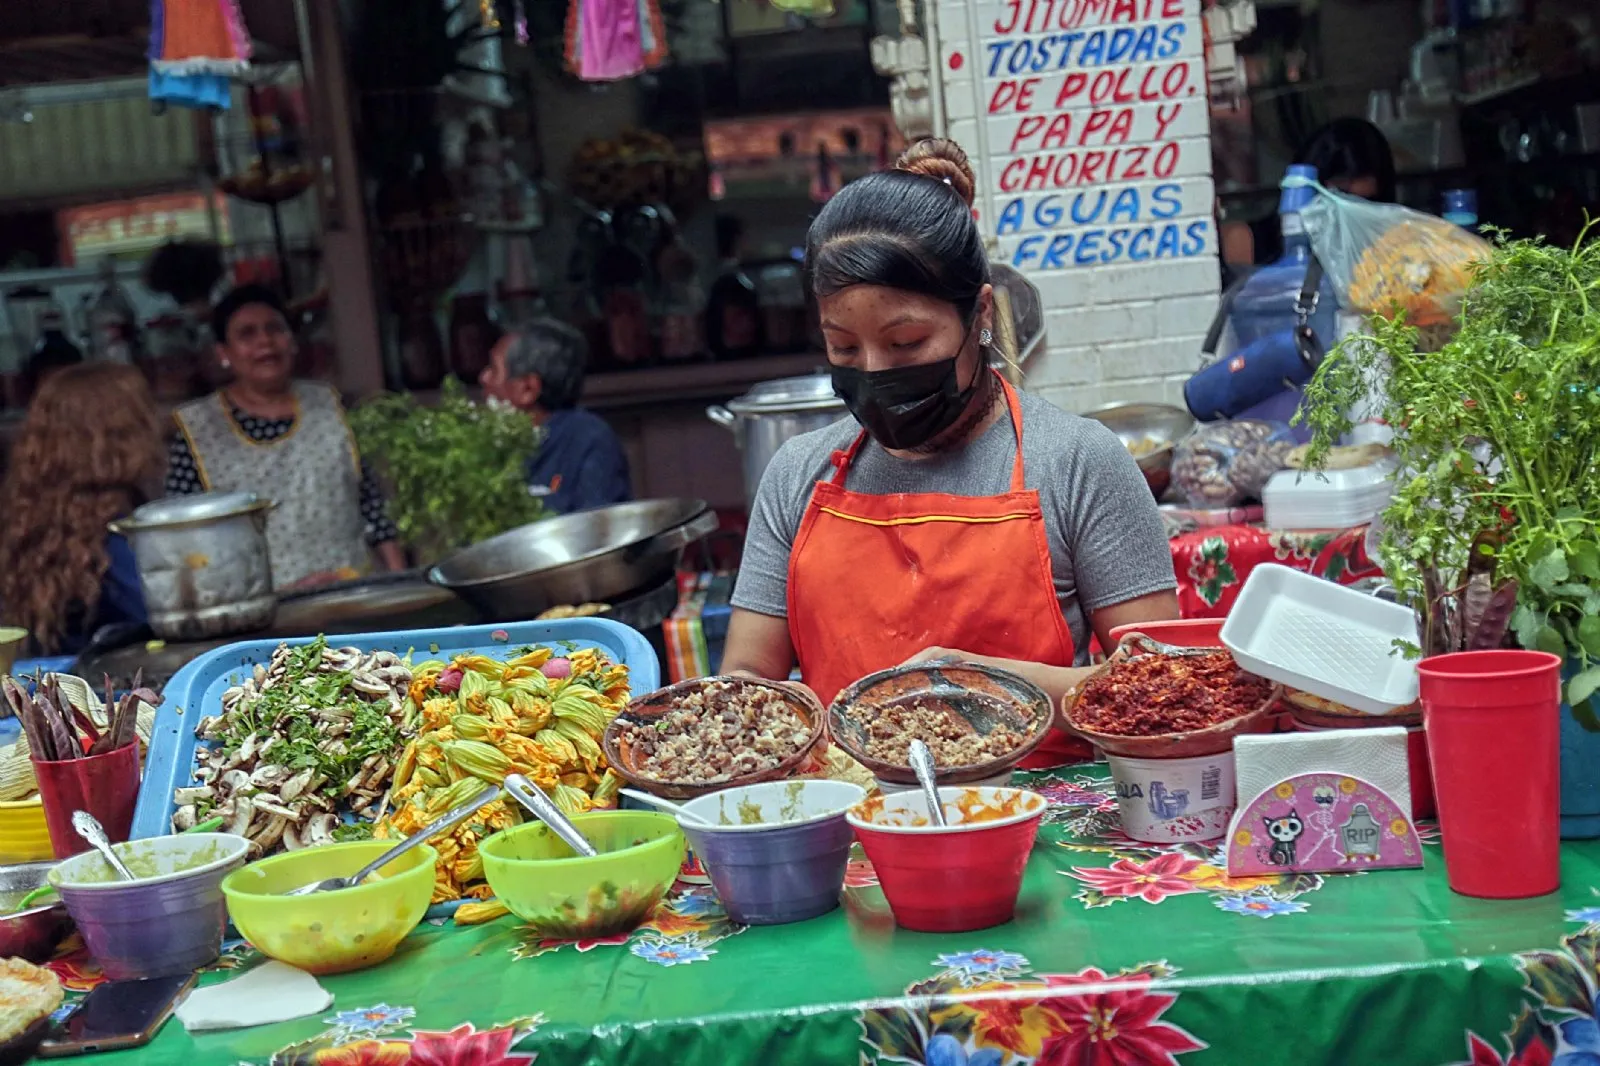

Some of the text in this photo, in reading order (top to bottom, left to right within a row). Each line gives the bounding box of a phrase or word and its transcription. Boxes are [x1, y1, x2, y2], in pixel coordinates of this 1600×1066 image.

[995, 0, 1184, 34] JITOMATE
[988, 23, 1186, 77] TOSTADAS
[989, 62, 1196, 114] DE POLLO.
[1010, 104, 1182, 152] PAPA Y
[999, 142, 1180, 192] CHORIZO
[997, 184, 1183, 235] AGUAS
[1012, 222, 1206, 270] FRESCAS
[1347, 828, 1376, 843] RIP
